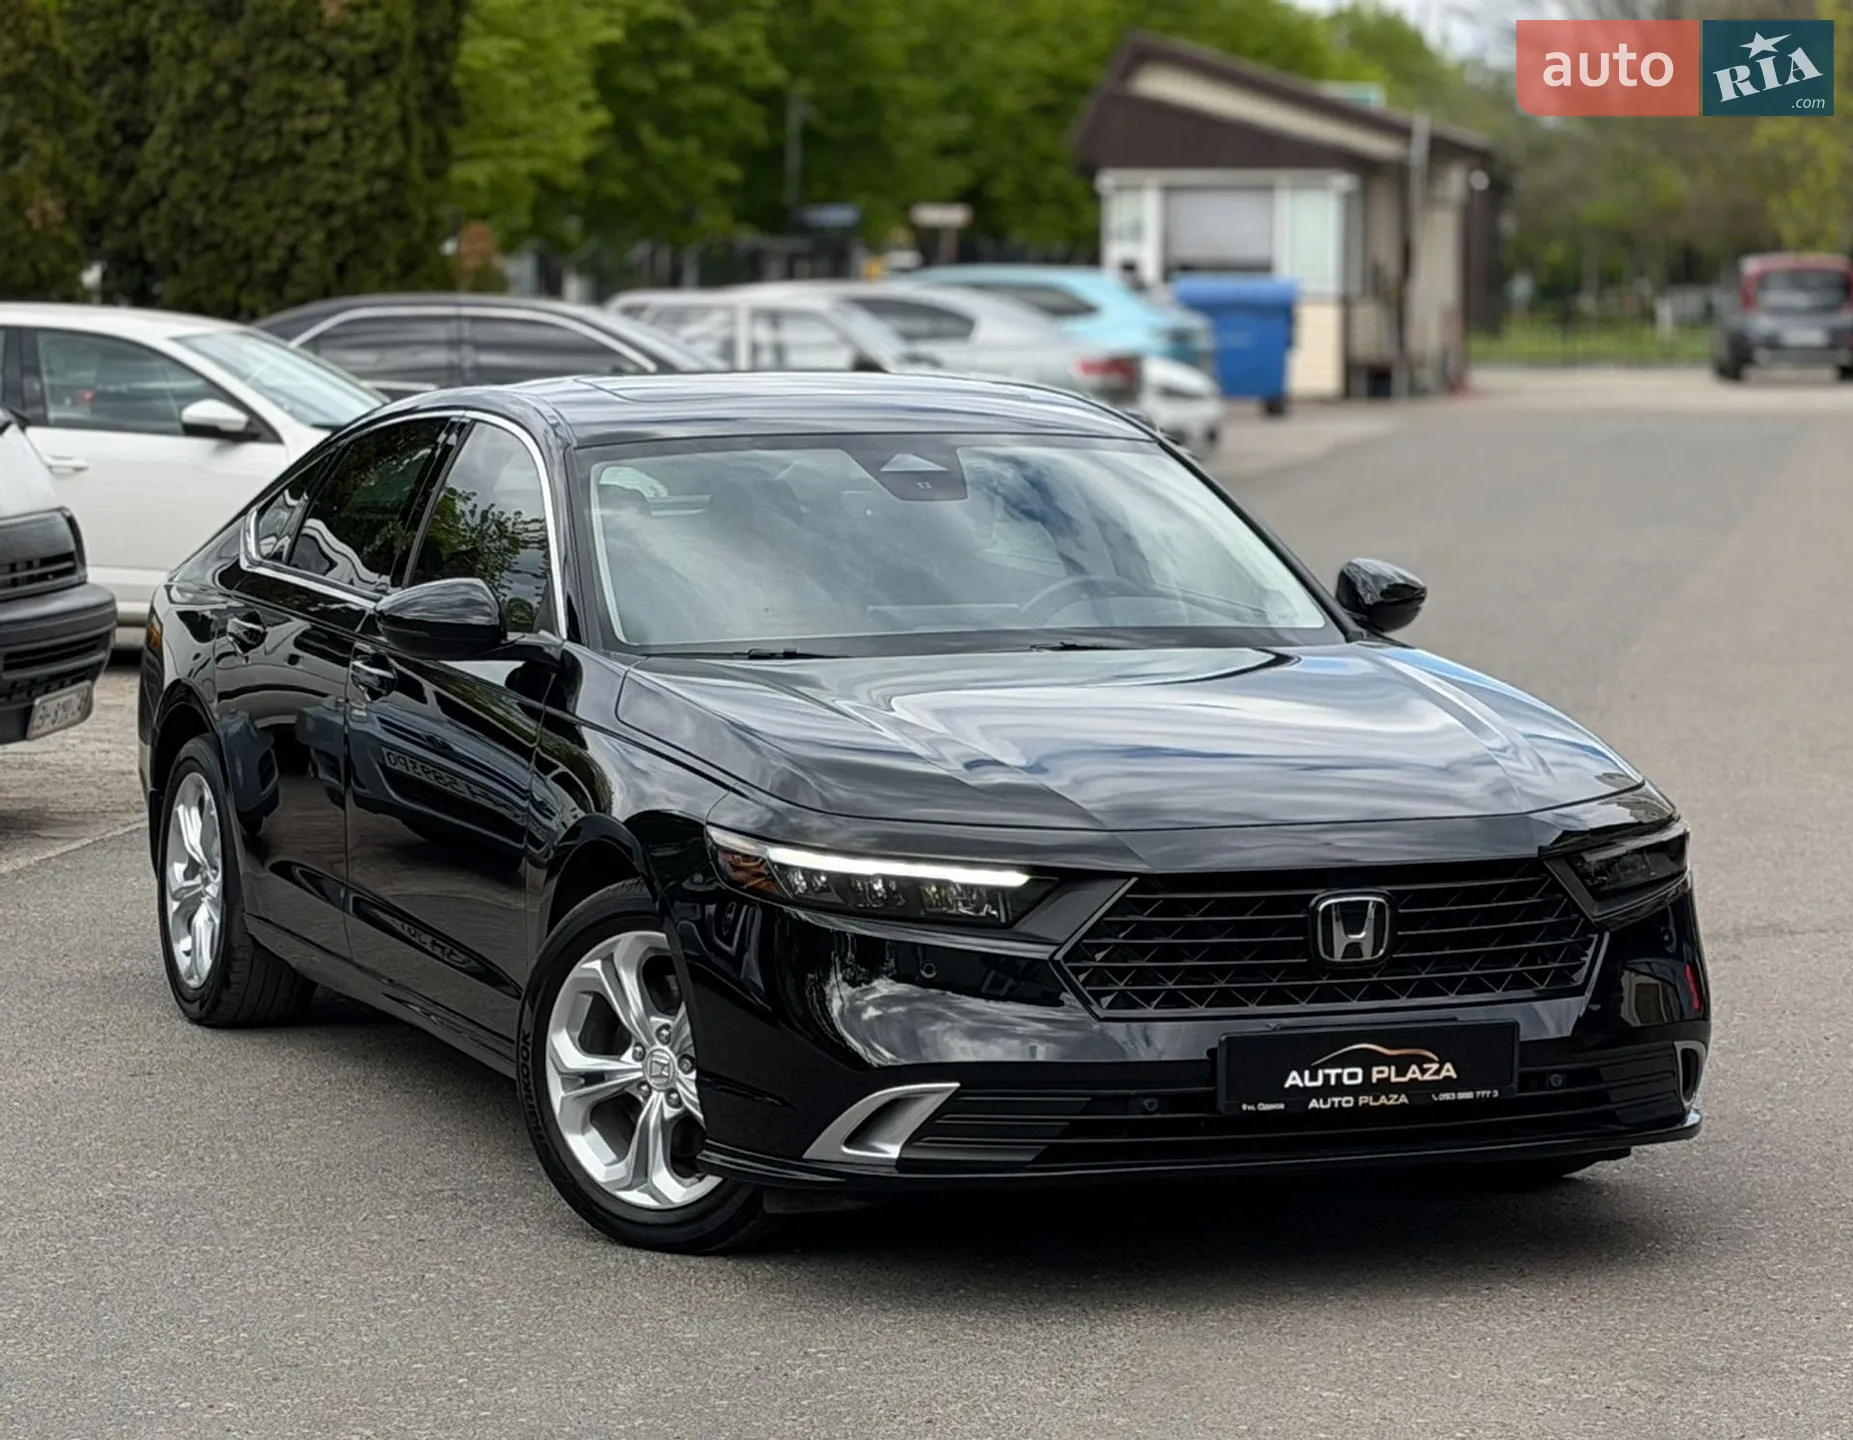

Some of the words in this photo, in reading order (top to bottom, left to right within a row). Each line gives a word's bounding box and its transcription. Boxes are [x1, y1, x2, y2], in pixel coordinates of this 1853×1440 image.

[1284, 1067, 1363, 1089] AUTO
[1371, 1062, 1458, 1083] PLAZA
[1308, 1096, 1354, 1109] AUTO
[1358, 1093, 1409, 1106] PLAZA
